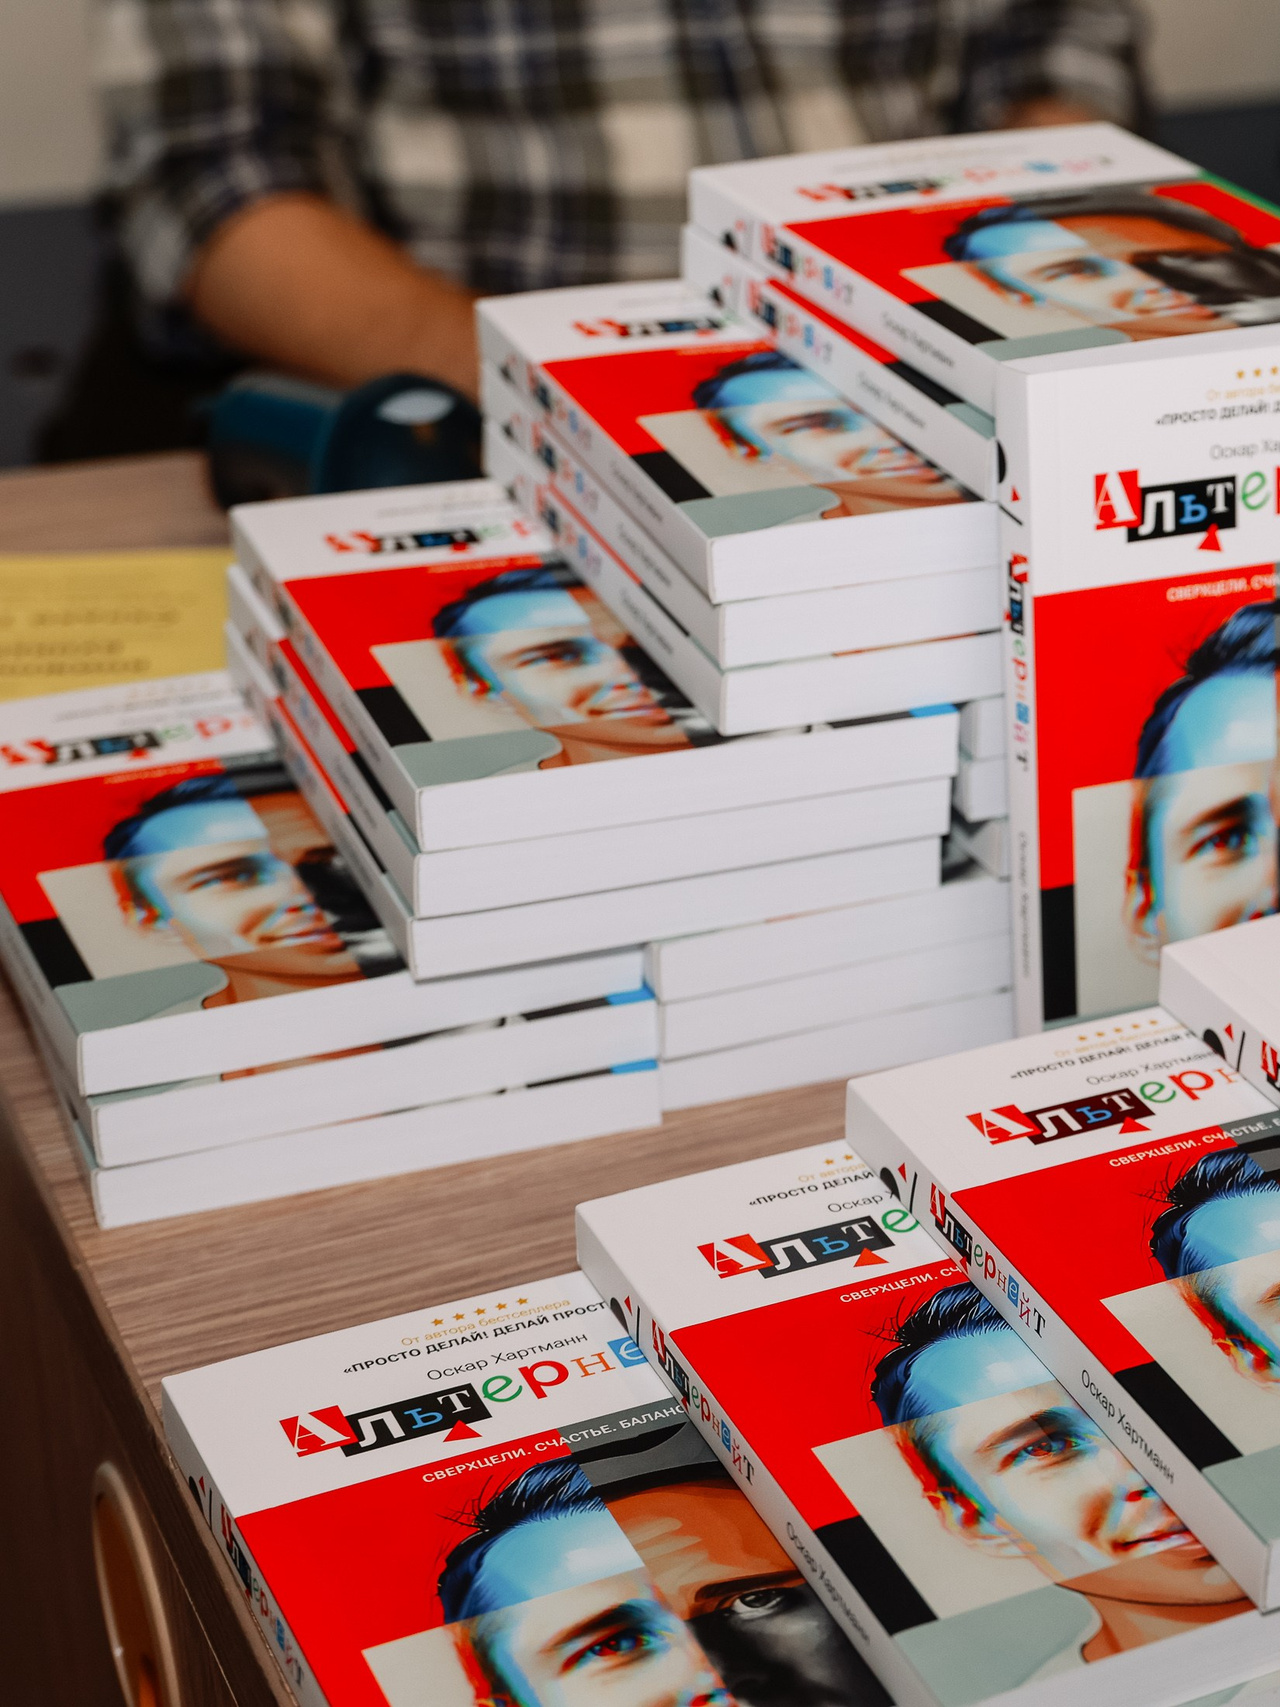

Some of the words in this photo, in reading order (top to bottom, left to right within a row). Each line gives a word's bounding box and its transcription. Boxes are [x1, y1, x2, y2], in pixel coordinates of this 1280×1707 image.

[1210, 443, 1258, 460] Оскар
[1010, 1060, 1076, 1080] «ПРОСТО
[1135, 1033, 1182, 1052] ДЕЛАЙ
[1086, 1068, 1140, 1086] Оскар
[1109, 1140, 1201, 1167] СВЕРХЦЕЛИ.
[1202, 1121, 1272, 1144] СЧАСТЬЕ.
[749, 1182, 818, 1207] «ПРОСТО
[798, 1174, 815, 1184] От
[827, 1195, 883, 1213] Оскар
[839, 1272, 938, 1304] СВЕРХЦЕЛИ.
[343, 1348, 421, 1375] «ПРОСТО
[426, 1330, 490, 1355] ДЕЛАЙ!
[493, 1314, 551, 1338] ДЕЛАЙ
[401, 1335, 421, 1347] От
[424, 1321, 477, 1341] автора
[479, 1298, 572, 1328] бестселлера
[427, 1359, 488, 1381] Оскар
[491, 1333, 589, 1365] Хартманн
[1081, 1369, 1116, 1419] Оскар
[1117, 1407, 1175, 1484] Хартманн
[422, 1447, 531, 1484] СВЕРХЦЕЛИ.
[534, 1425, 616, 1451] СЧАСТЬЕ.
